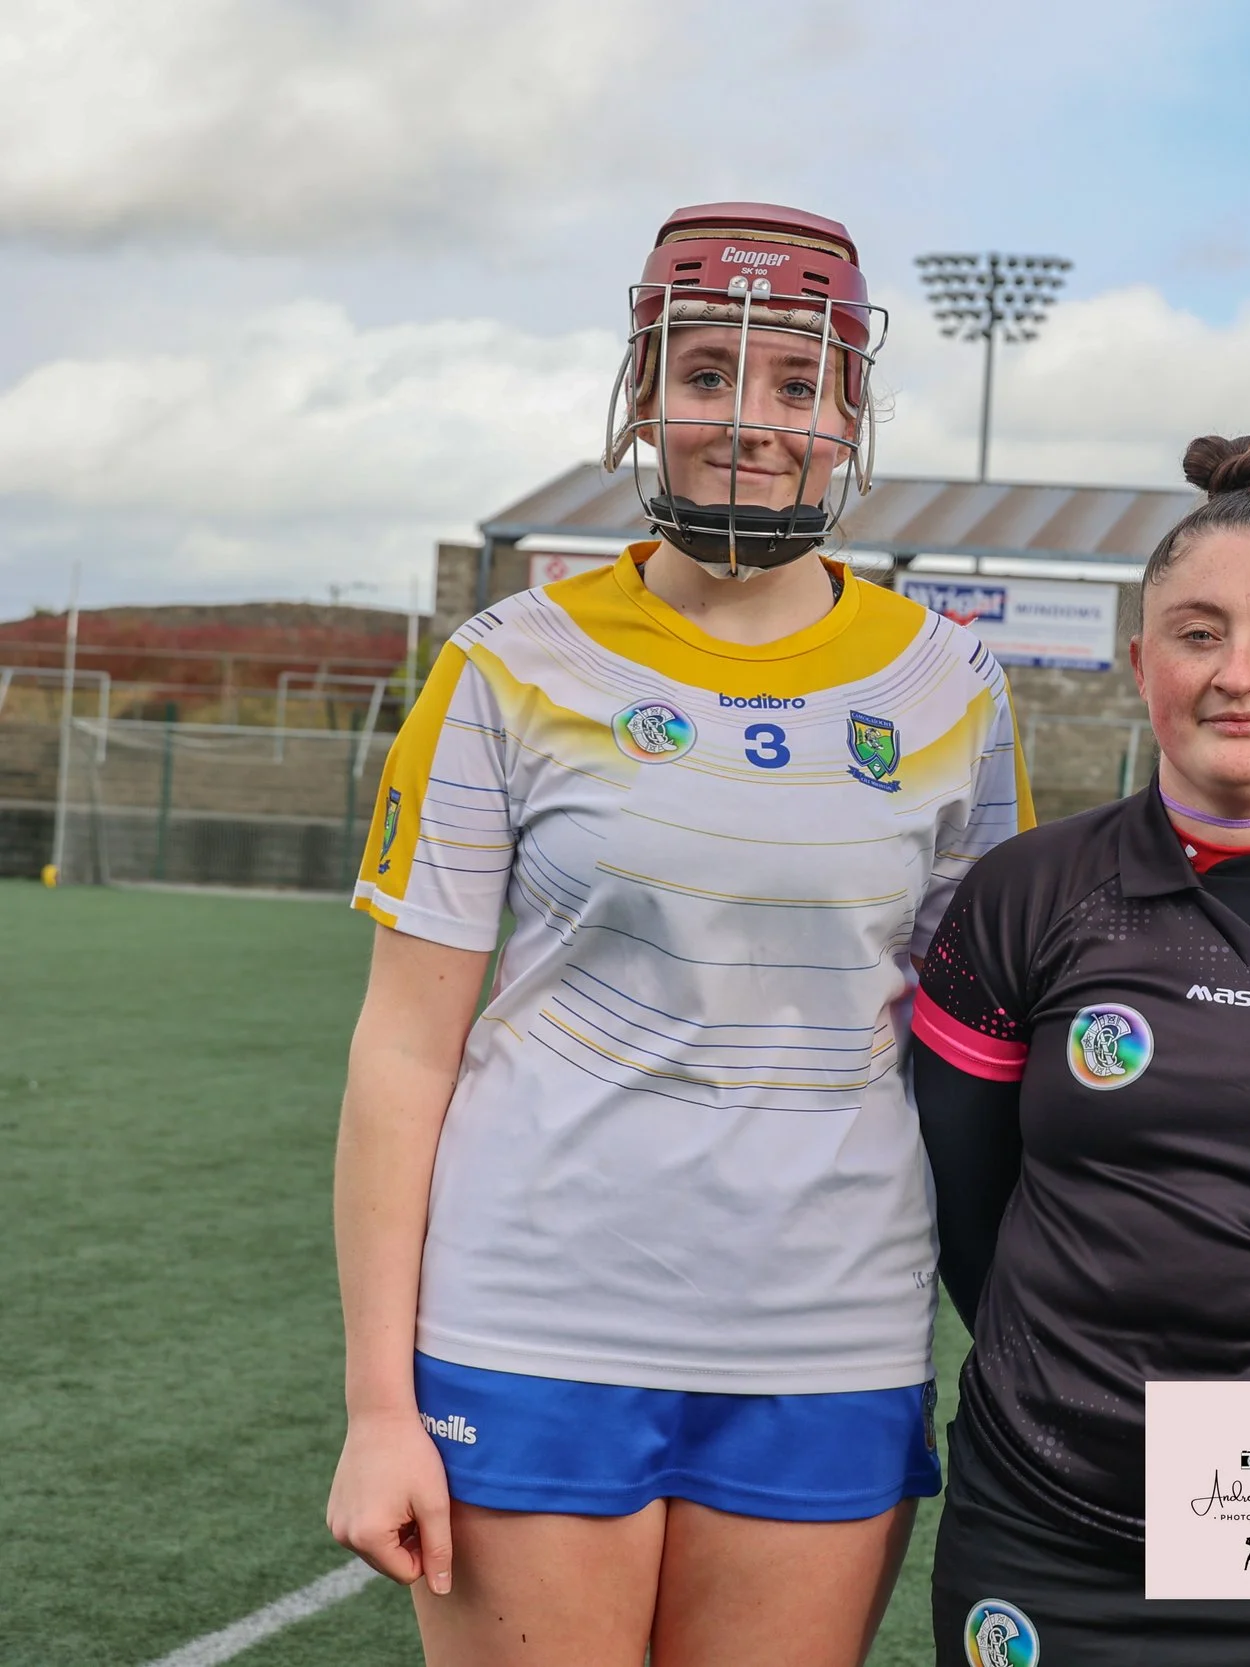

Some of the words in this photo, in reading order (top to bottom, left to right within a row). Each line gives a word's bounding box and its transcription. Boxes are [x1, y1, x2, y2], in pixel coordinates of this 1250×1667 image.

[721, 246, 789, 267] Cooper
[741, 267, 753, 275] SK
[755, 268, 767, 276] 100
[719, 693, 805, 709] bodibro
[744, 723, 790, 769] 3
